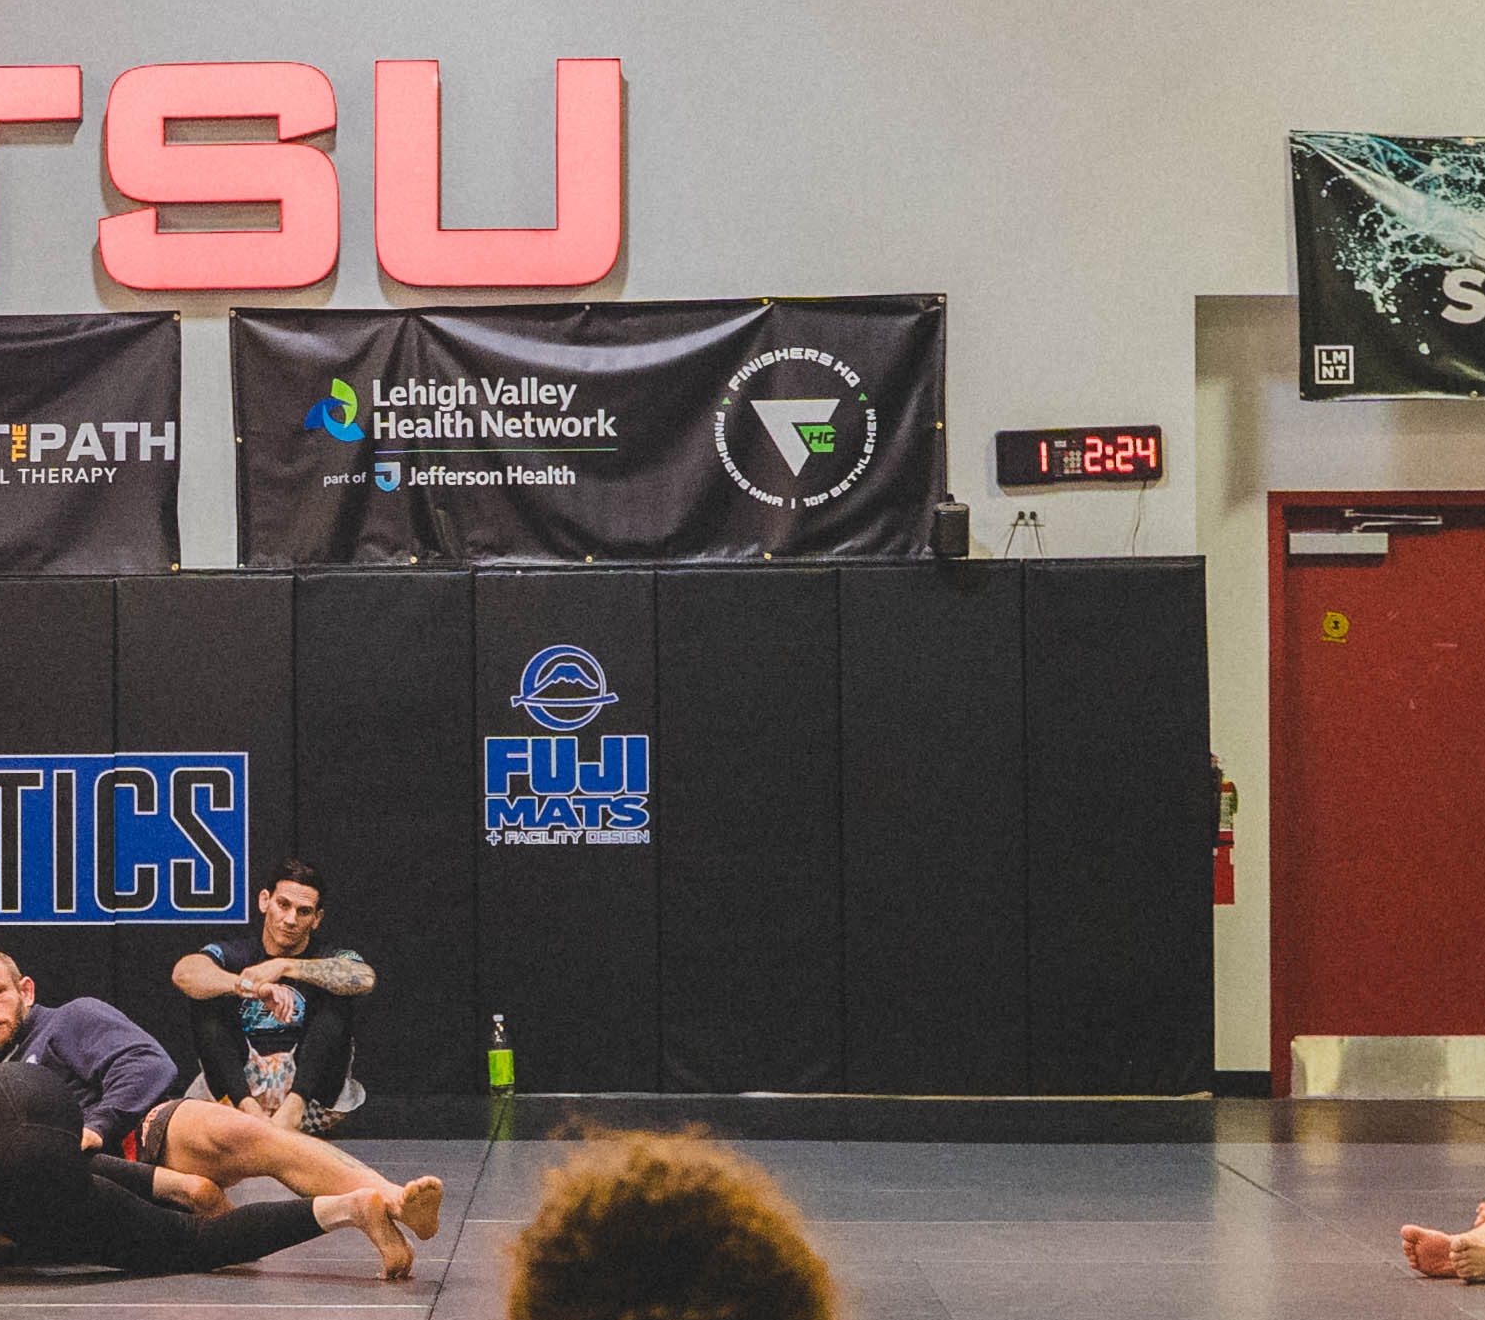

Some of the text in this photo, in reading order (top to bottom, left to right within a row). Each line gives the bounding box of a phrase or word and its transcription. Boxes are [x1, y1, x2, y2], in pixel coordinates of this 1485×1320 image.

[728, 347, 835, 392] FINISHERS
[372, 377, 578, 412] Lehigh Valley
[11, 423, 27, 463] THE
[30, 420, 177, 463] PATH
[373, 408, 618, 440] Health Network
[714, 411, 751, 490] FINISHERS
[17, 467, 118, 485] THERAPY
[323, 465, 577, 487] part of Jefferson Health
[484, 734, 650, 796] FUJI
[485, 795, 650, 831] MATS
[504, 830, 584, 845] FACILITY
[586, 830, 650, 844] DESIGN
